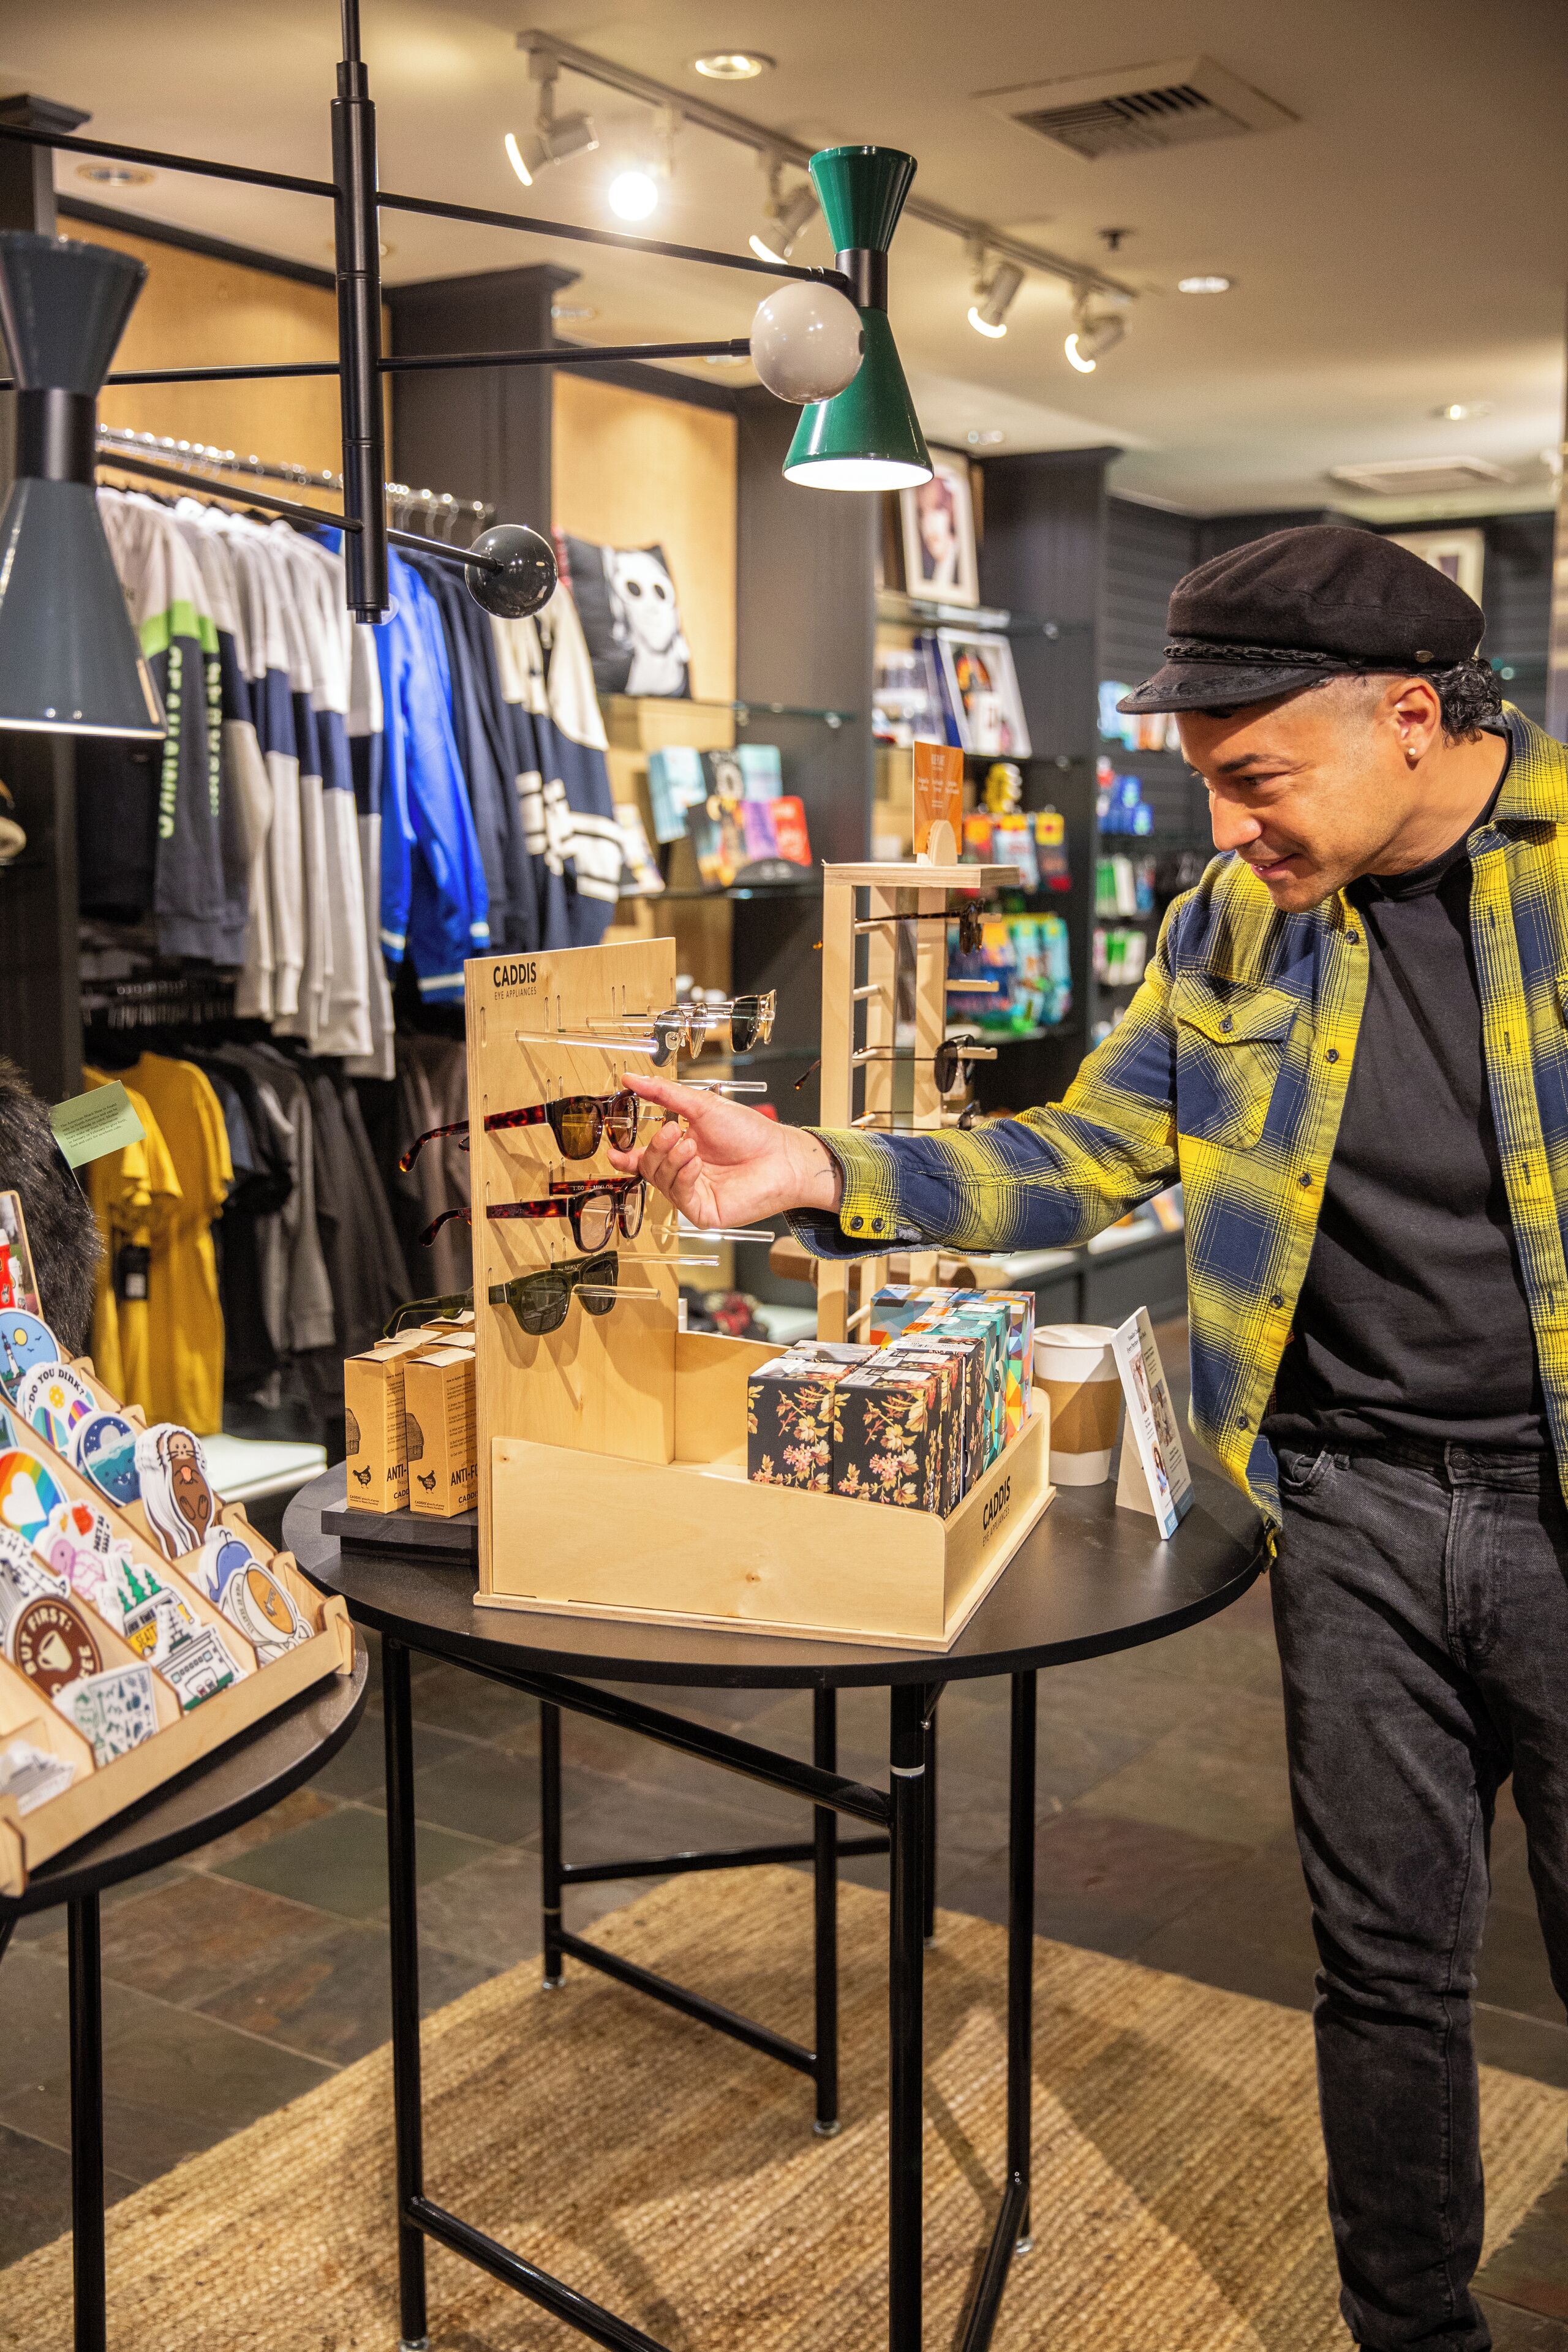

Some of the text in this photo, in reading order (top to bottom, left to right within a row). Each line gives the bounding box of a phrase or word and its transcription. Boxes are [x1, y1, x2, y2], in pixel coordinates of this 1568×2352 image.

[494, 962, 536, 987] CADDIS
[494, 987, 537, 1000] EYE APPLIANCES
[29, 1384, 38, 1403] DO
[37, 1368, 55, 1384] YOU
[983, 1476, 1011, 1531] CADDIS
[990, 1504, 1010, 1535] APPLIANCES
[239, 1608, 254, 1634] SEATTLE
[21, 1607, 73, 1676] BUT FIRST:
[51, 1644, 94, 1697] CFEE
